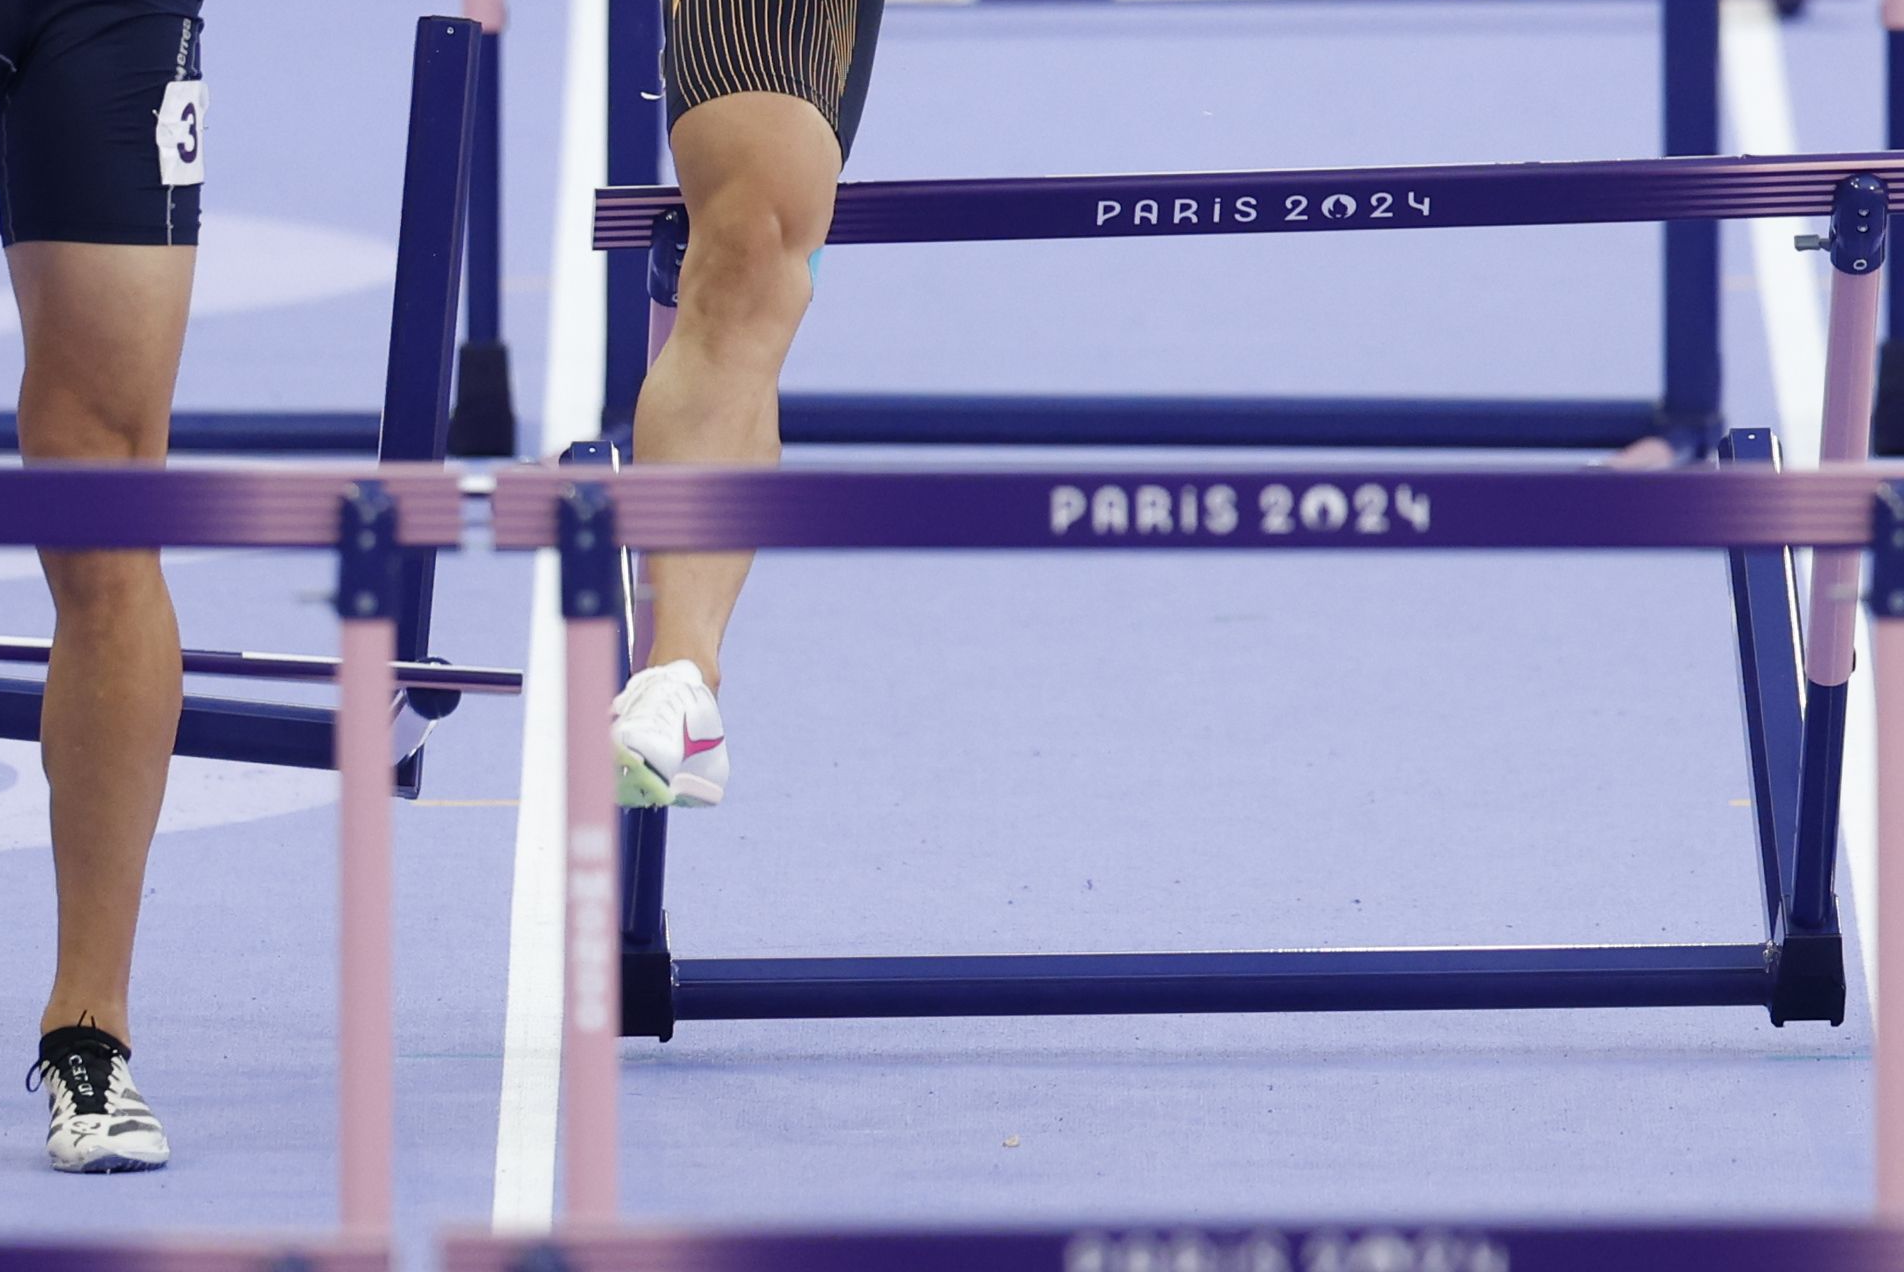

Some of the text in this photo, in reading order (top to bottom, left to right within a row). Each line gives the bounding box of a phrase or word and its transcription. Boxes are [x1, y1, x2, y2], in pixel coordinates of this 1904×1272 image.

[176, 102, 199, 164] 3
[1096, 191, 1431, 226] PARIS 2024
[1049, 482, 1431, 536] PARIS 2024
